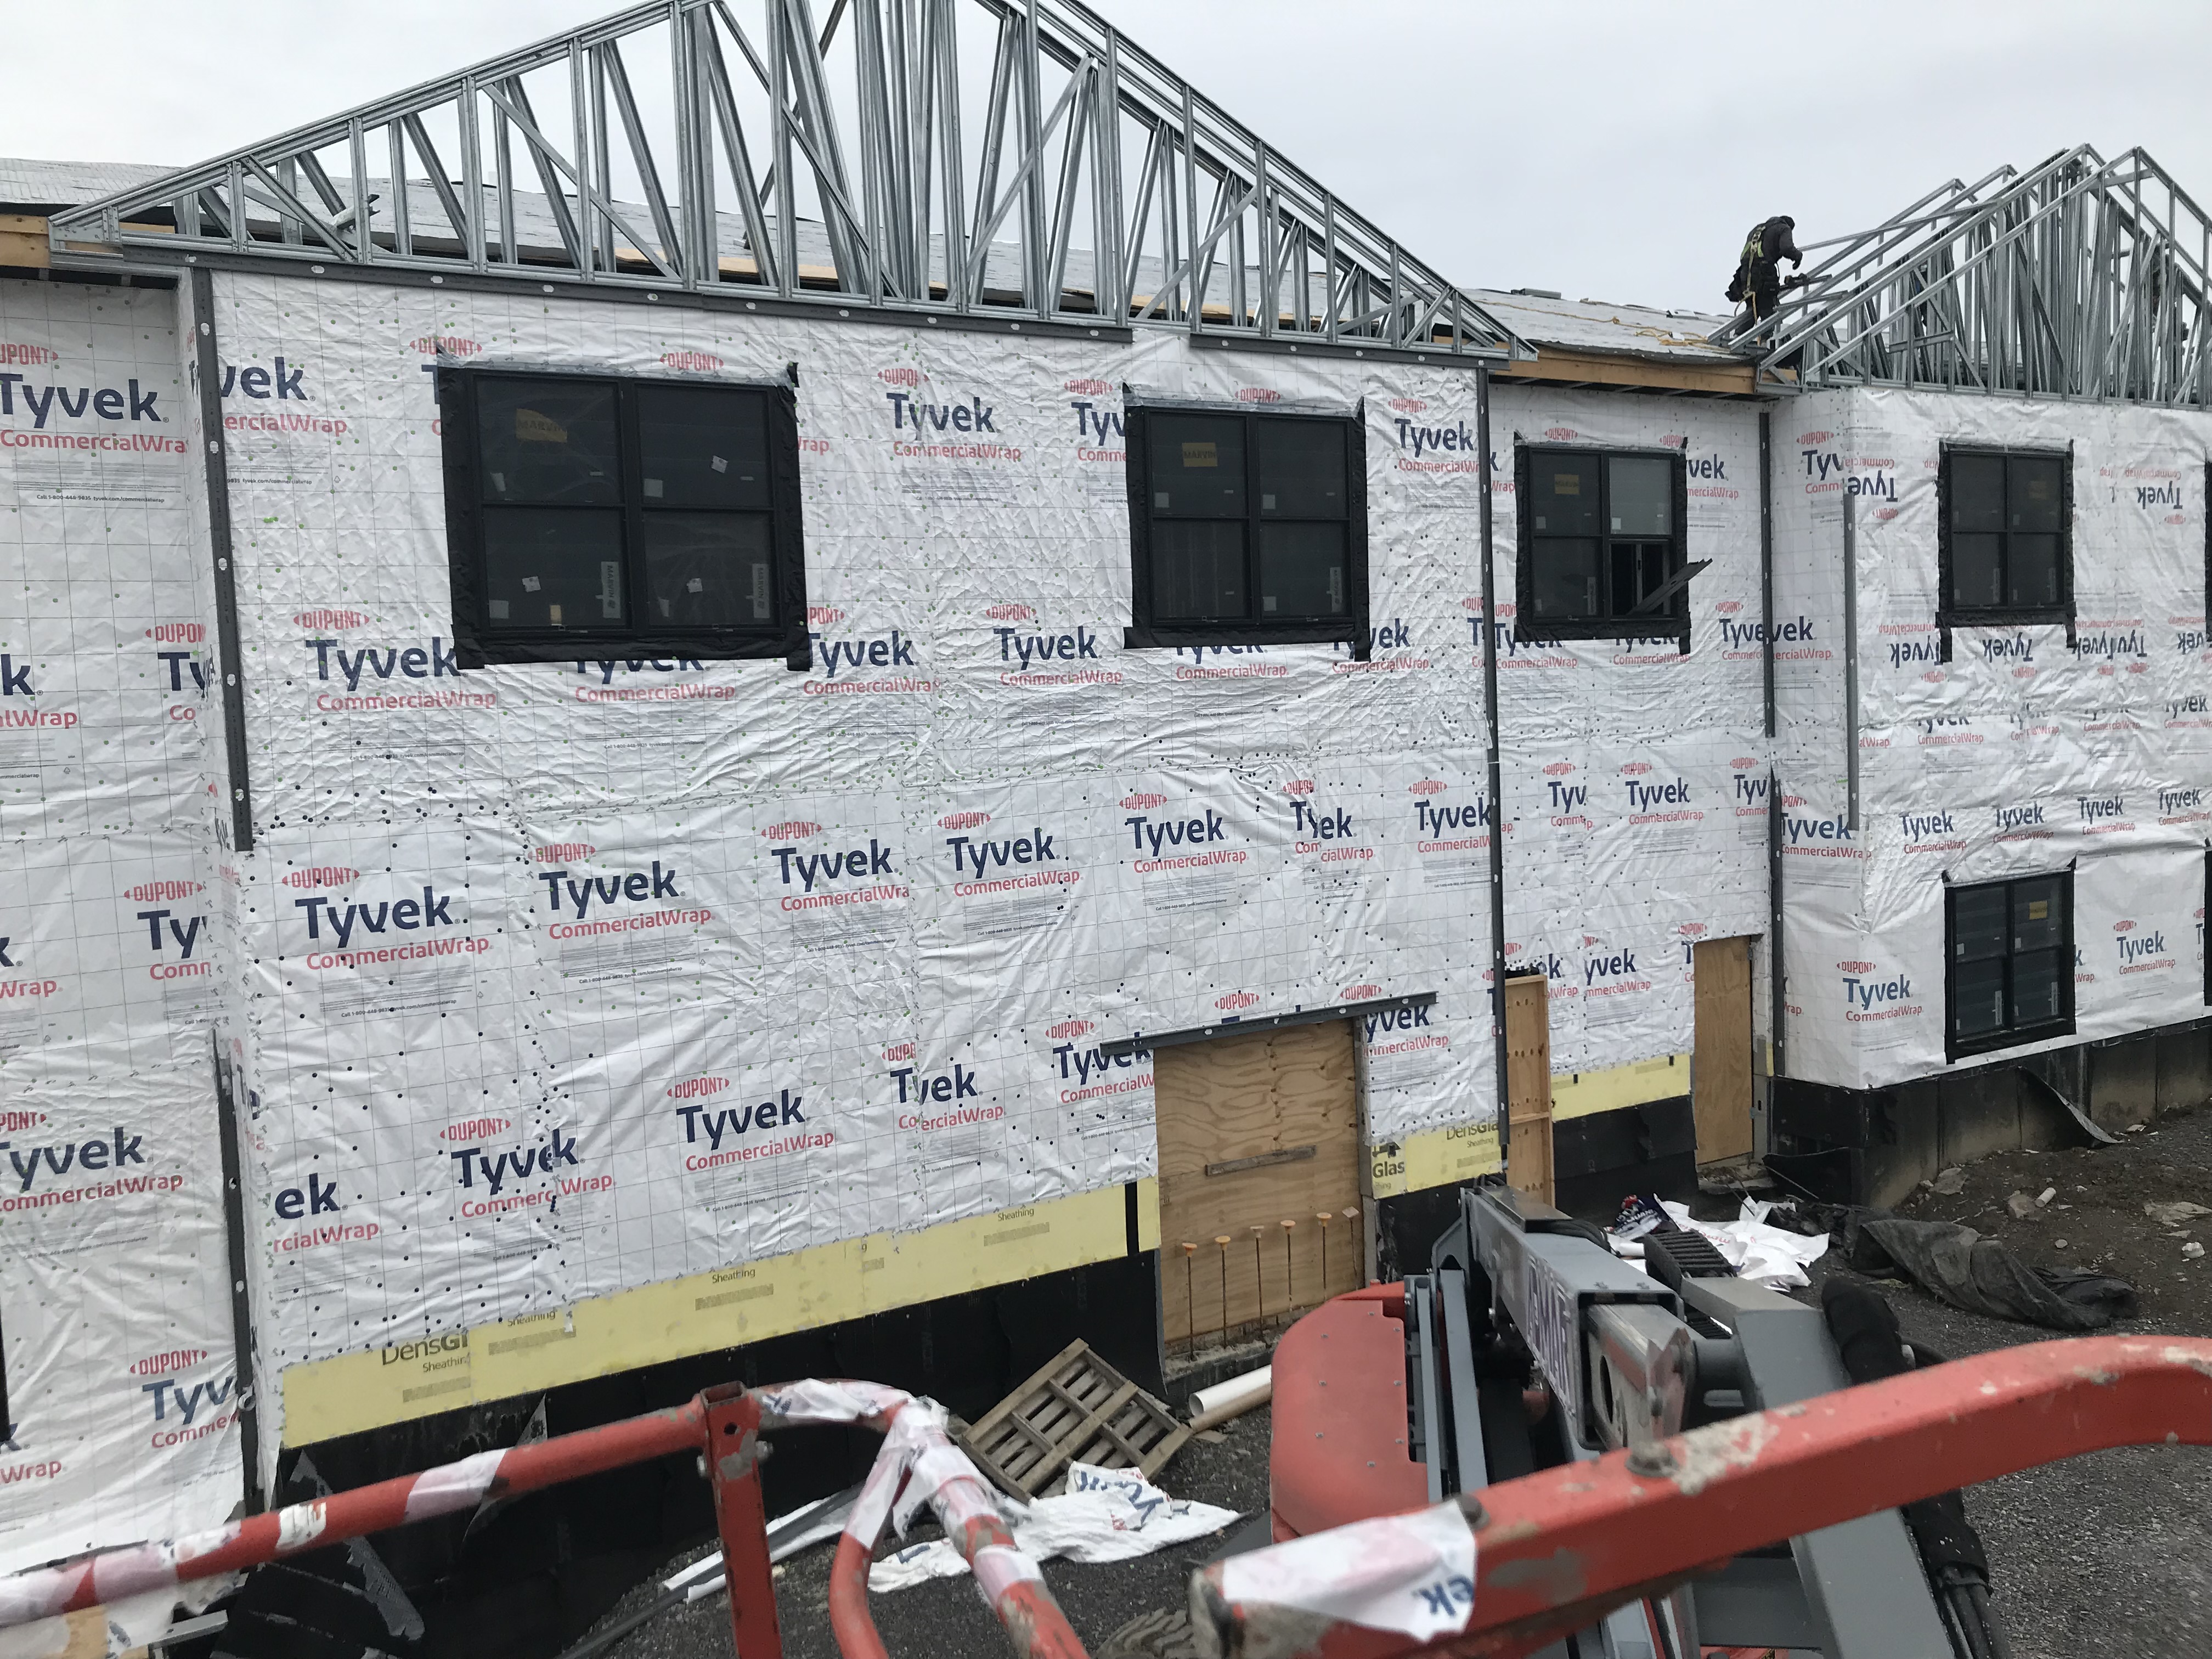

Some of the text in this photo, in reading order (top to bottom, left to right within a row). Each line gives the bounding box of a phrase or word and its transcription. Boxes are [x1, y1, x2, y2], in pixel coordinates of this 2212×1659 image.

[0, 344, 49, 365] UPONT
[667, 352, 717, 371] DUPONT
[221, 357, 308, 401] vek
[1070, 379, 1108, 396] DUPONT
[0, 373, 161, 428] Tyvek
[1240, 389, 1276, 403] DUPONT
[1393, 399, 1423, 413] DUPONT
[224, 413, 348, 437] ercialWrap
[887, 393, 994, 441] Tyvek
[1071, 402, 1125, 446] Tyv
[0, 428, 185, 454] CommercialWra
[1395, 419, 1474, 457] Tyvek
[1548, 427, 1575, 440] DUPONT
[1801, 432, 1830, 445] DUPONT
[893, 441, 1022, 462] CommercialWrap
[1688, 454, 1725, 479] vek
[1802, 449, 1844, 480] Tyv
[1688, 487, 1739, 500] mercialWrap
[1848, 470, 1898, 503] Tyve
[303, 610, 362, 630] DUPONT
[809, 607, 840, 625] PONT
[992, 604, 1032, 621] DUPONT
[155, 623, 206, 643] DUPON
[1772, 616, 1813, 642] vek
[994, 626, 1097, 670] Tyvek
[1773, 647, 1832, 661] ercialWrap
[306, 636, 461, 691] Tyvek
[1176, 663, 1287, 681] CommercialWrap
[1496, 656, 1578, 670] CommercialWrap
[1000, 669, 1123, 687] CommercialWrap
[317, 689, 497, 712] CommercialWrap
[575, 684, 735, 704] CommercialWrap
[1545, 761, 1572, 776] DUPONT
[1624, 761, 1649, 776] DUPONT
[1732, 757, 1757, 770] DUPONT
[1413, 780, 1443, 795] DUPONT
[1547, 780, 1587, 814] Tyv
[1624, 776, 1690, 812] Tyvek
[1734, 773, 1768, 805] Tyv
[1125, 793, 1163, 810] DUPONT
[2077, 796, 2123, 824] Tyvek
[944, 812, 985, 830] DUPONT
[1414, 797, 1491, 838] Tyvek
[1629, 809, 1704, 825] CommercialWrap
[1900, 809, 1954, 843] Tyvek
[769, 821, 815, 840] DUPONT
[1126, 809, 1224, 856] Tyvek
[536, 843, 589, 864] DUPONT
[946, 827, 1056, 879] Tyvek
[1904, 840, 1967, 855] CommercialWrap
[771, 839, 893, 892] Tyvek
[1133, 849, 1248, 874] CommercialWrap
[291, 867, 352, 888] DUPONT
[953, 868, 1080, 899] CommercialWrap
[133, 881, 195, 902] DUPONT
[539, 860, 680, 919] Tyvek
[780, 884, 911, 912] CommercialWra
[295, 886, 451, 948] Tyvek
[549, 908, 712, 940] CommercialWrap
[307, 935, 489, 970] CommercialWrap
[2117, 930, 2164, 964] Tyvek
[1585, 948, 1636, 985] yvek
[1842, 961, 1872, 974] DUPONT
[2119, 958, 2175, 975] CommercialWrap
[1220, 992, 1255, 1011] DUPONT
[1345, 985, 1378, 1001] DUPONT
[1842, 974, 1910, 1010] Tyvek
[392, 999, 457, 1012] yvek.com/commercialwrap
[1846, 1005, 1922, 1022] CommercialWrap
[1052, 1020, 1089, 1039] DUPONT
[1365, 1003, 1430, 1042] yvek
[888, 1043, 916, 1062] DUPO
[675, 1077, 724, 1098] DUPONT
[448, 1118, 504, 1142] DUPONT
[675, 1088, 806, 1151] Tyvek
[686, 1130, 835, 1172] CommercialWrap
[1467, 1137, 1493, 1148] Sheathing
[0, 1127, 145, 1191] yvek
[1, 1175, 183, 1212] ommercialWrap
[998, 1206, 1035, 1222] Sheathing
[712, 1267, 755, 1283] Sheathing
[382, 1330, 469, 1365] DensGl
[139, 1349, 199, 1375] DUPONT
[422, 1352, 470, 1372] Sheathin
[143, 1376, 235, 1425] Tyv
